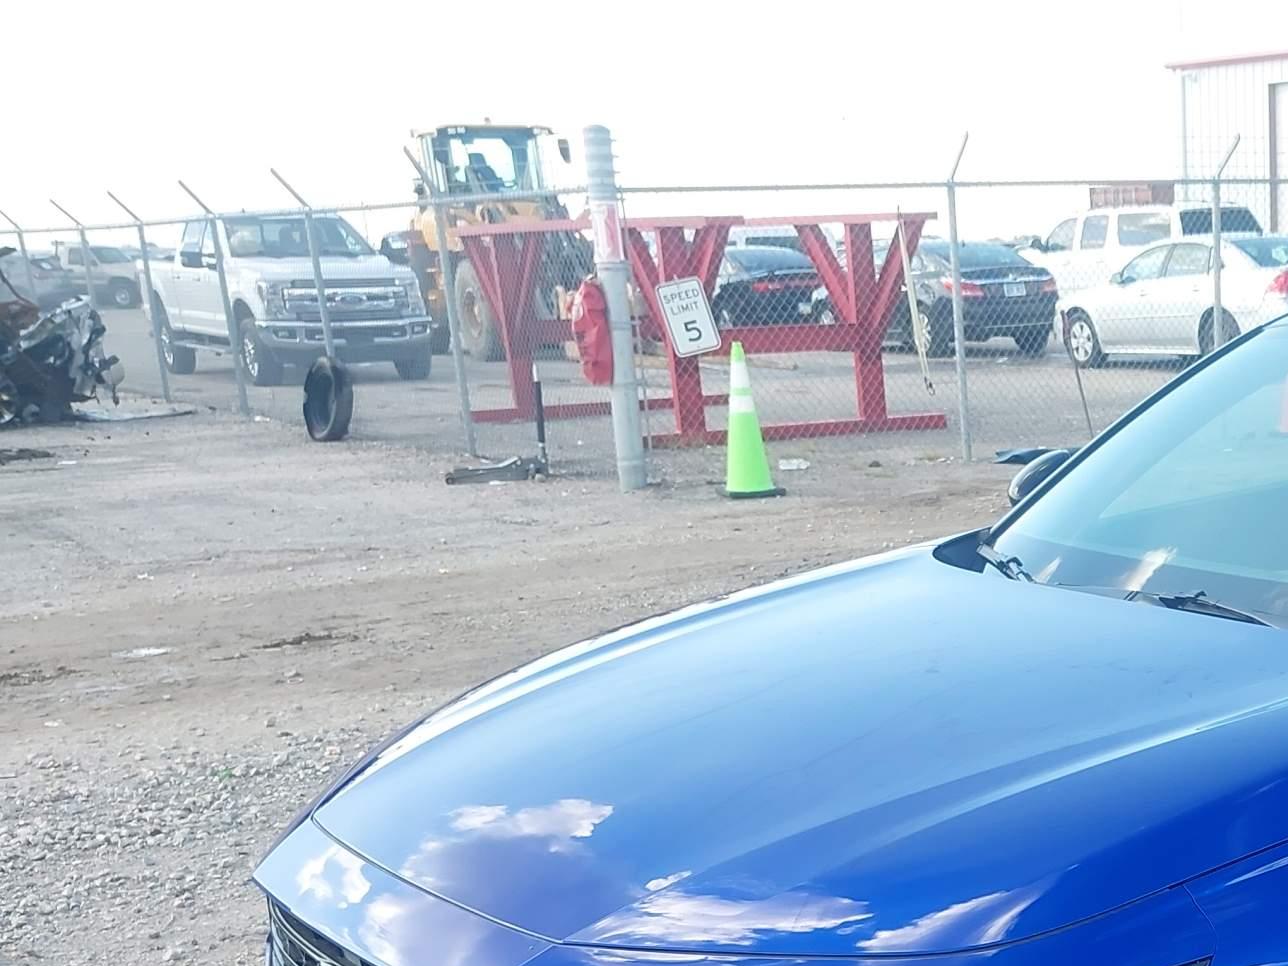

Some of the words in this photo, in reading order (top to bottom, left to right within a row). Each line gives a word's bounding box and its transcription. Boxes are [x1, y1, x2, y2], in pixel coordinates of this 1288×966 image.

[662, 288, 700, 305] SPEED
[670, 301, 700, 316] LIMIT
[683, 319, 703, 342] 5
